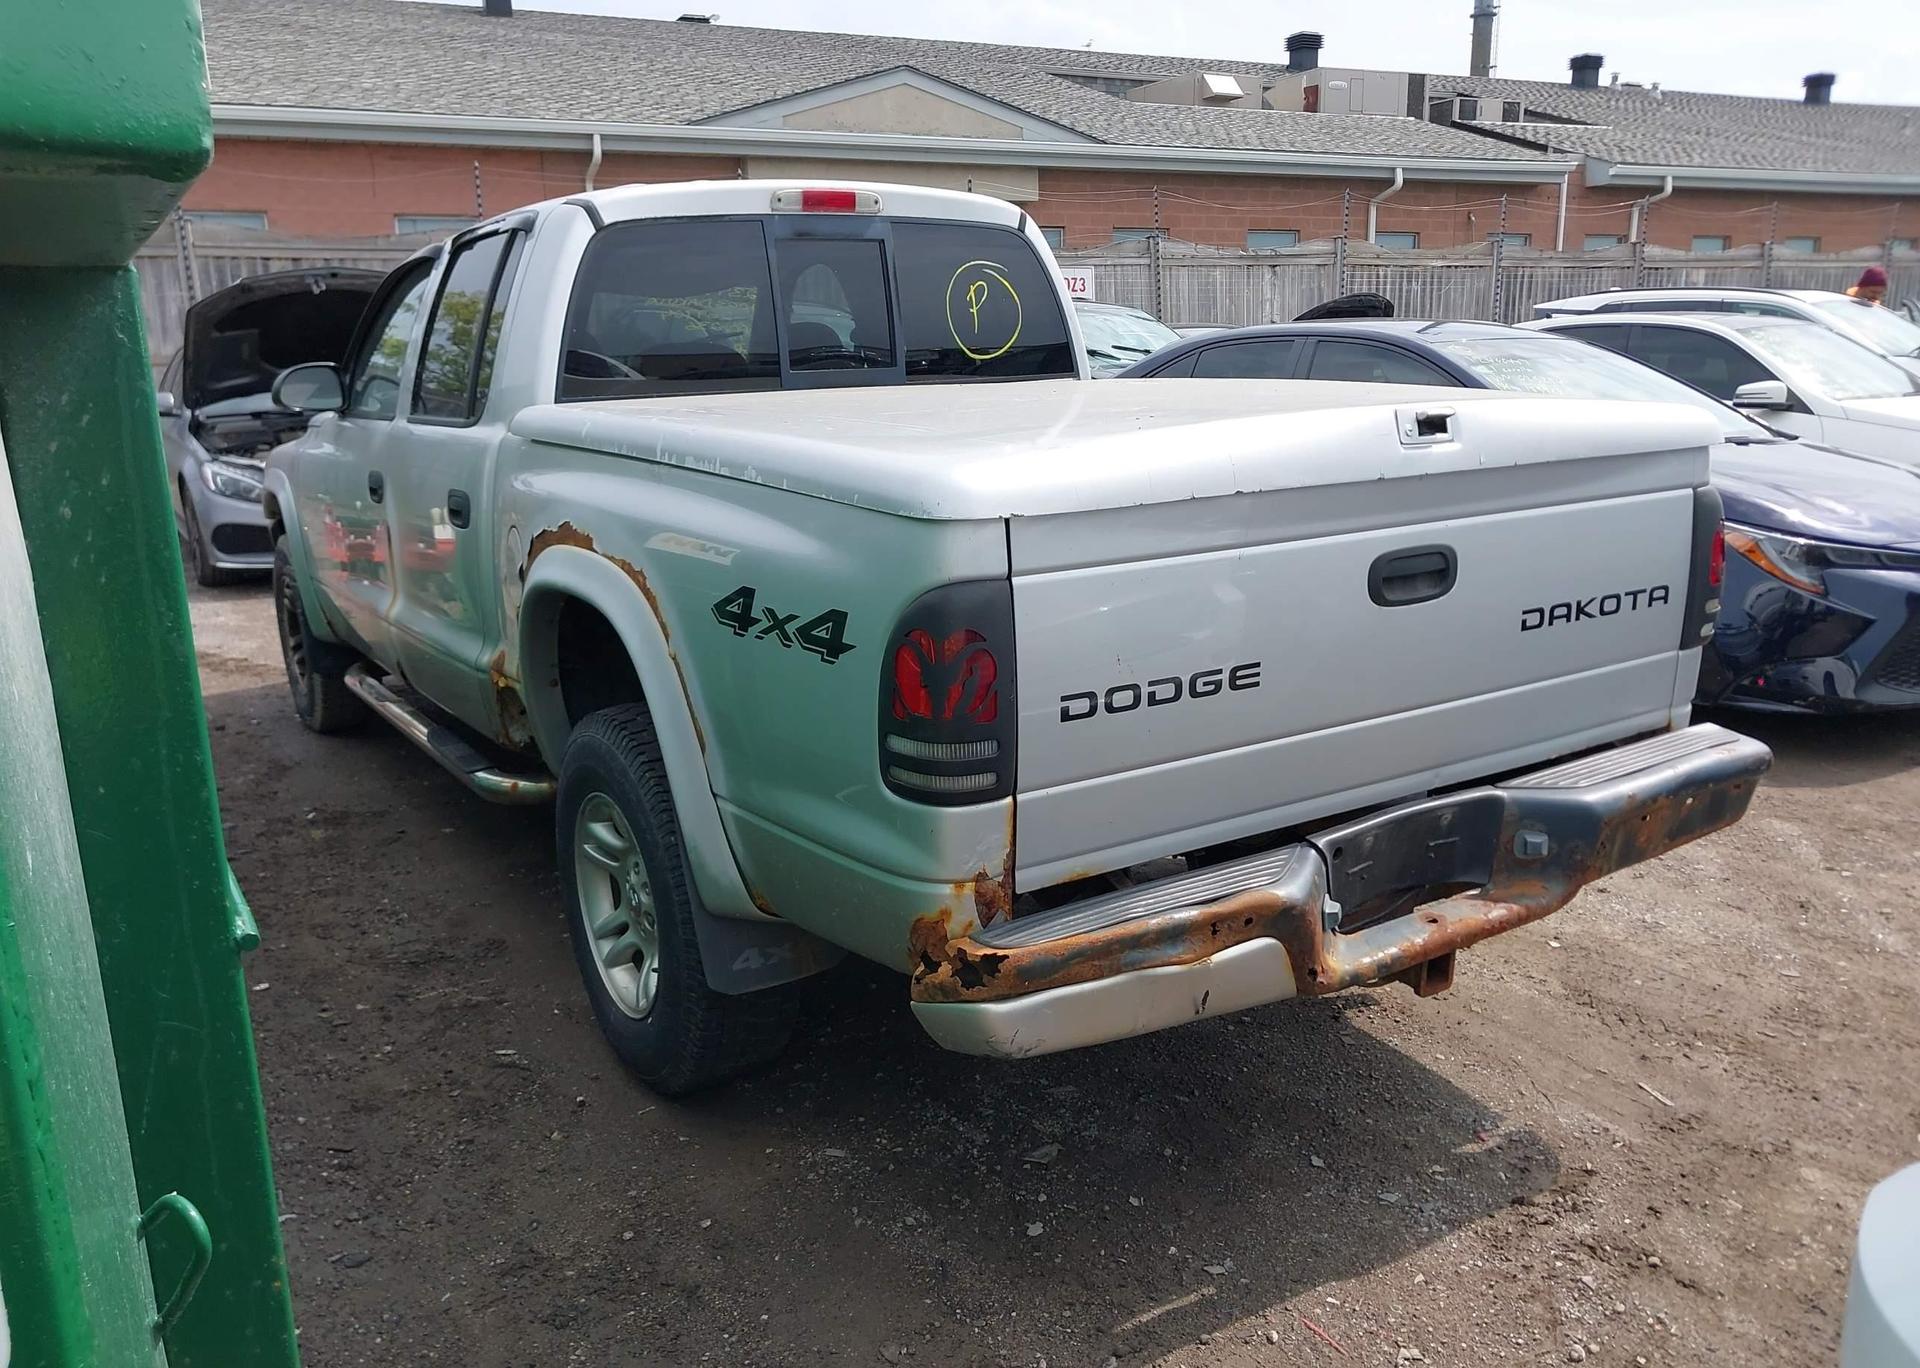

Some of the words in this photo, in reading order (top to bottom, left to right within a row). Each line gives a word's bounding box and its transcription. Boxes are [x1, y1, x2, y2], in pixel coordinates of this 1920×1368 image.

[966, 280, 988, 334] P
[1520, 584, 1670, 632] DAKOTA
[1060, 661, 1261, 723] DODGE
